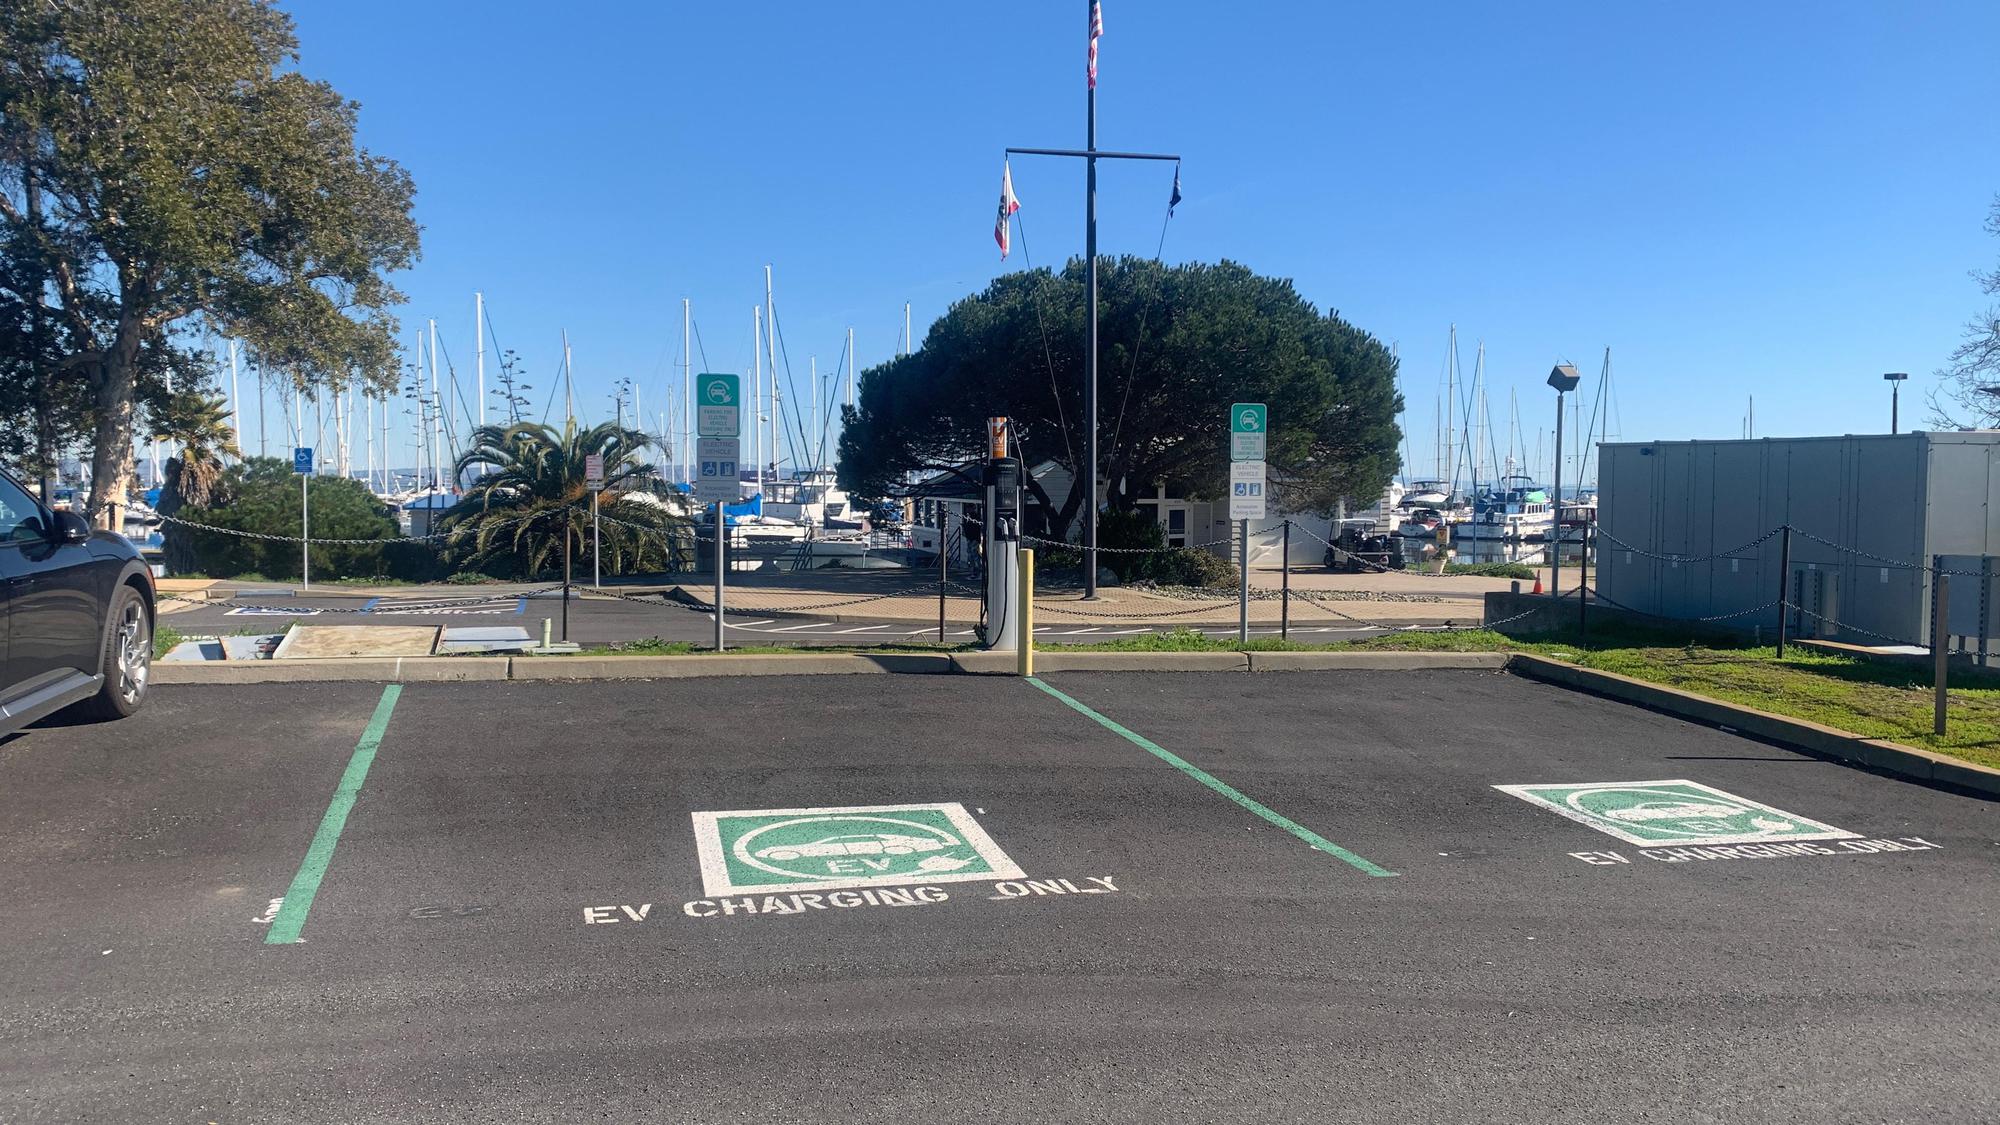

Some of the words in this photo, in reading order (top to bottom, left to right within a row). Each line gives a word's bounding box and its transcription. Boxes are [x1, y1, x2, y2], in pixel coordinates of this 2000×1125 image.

[1566, 851, 1632, 865] EV
[1638, 842, 1836, 863] CHARGING
[1838, 837, 1944, 852] ONLY
[826, 857, 891, 874] EV
[583, 904, 652, 924] EV
[683, 887, 949, 917] CHARGING
[995, 876, 1119, 897] ONLY
